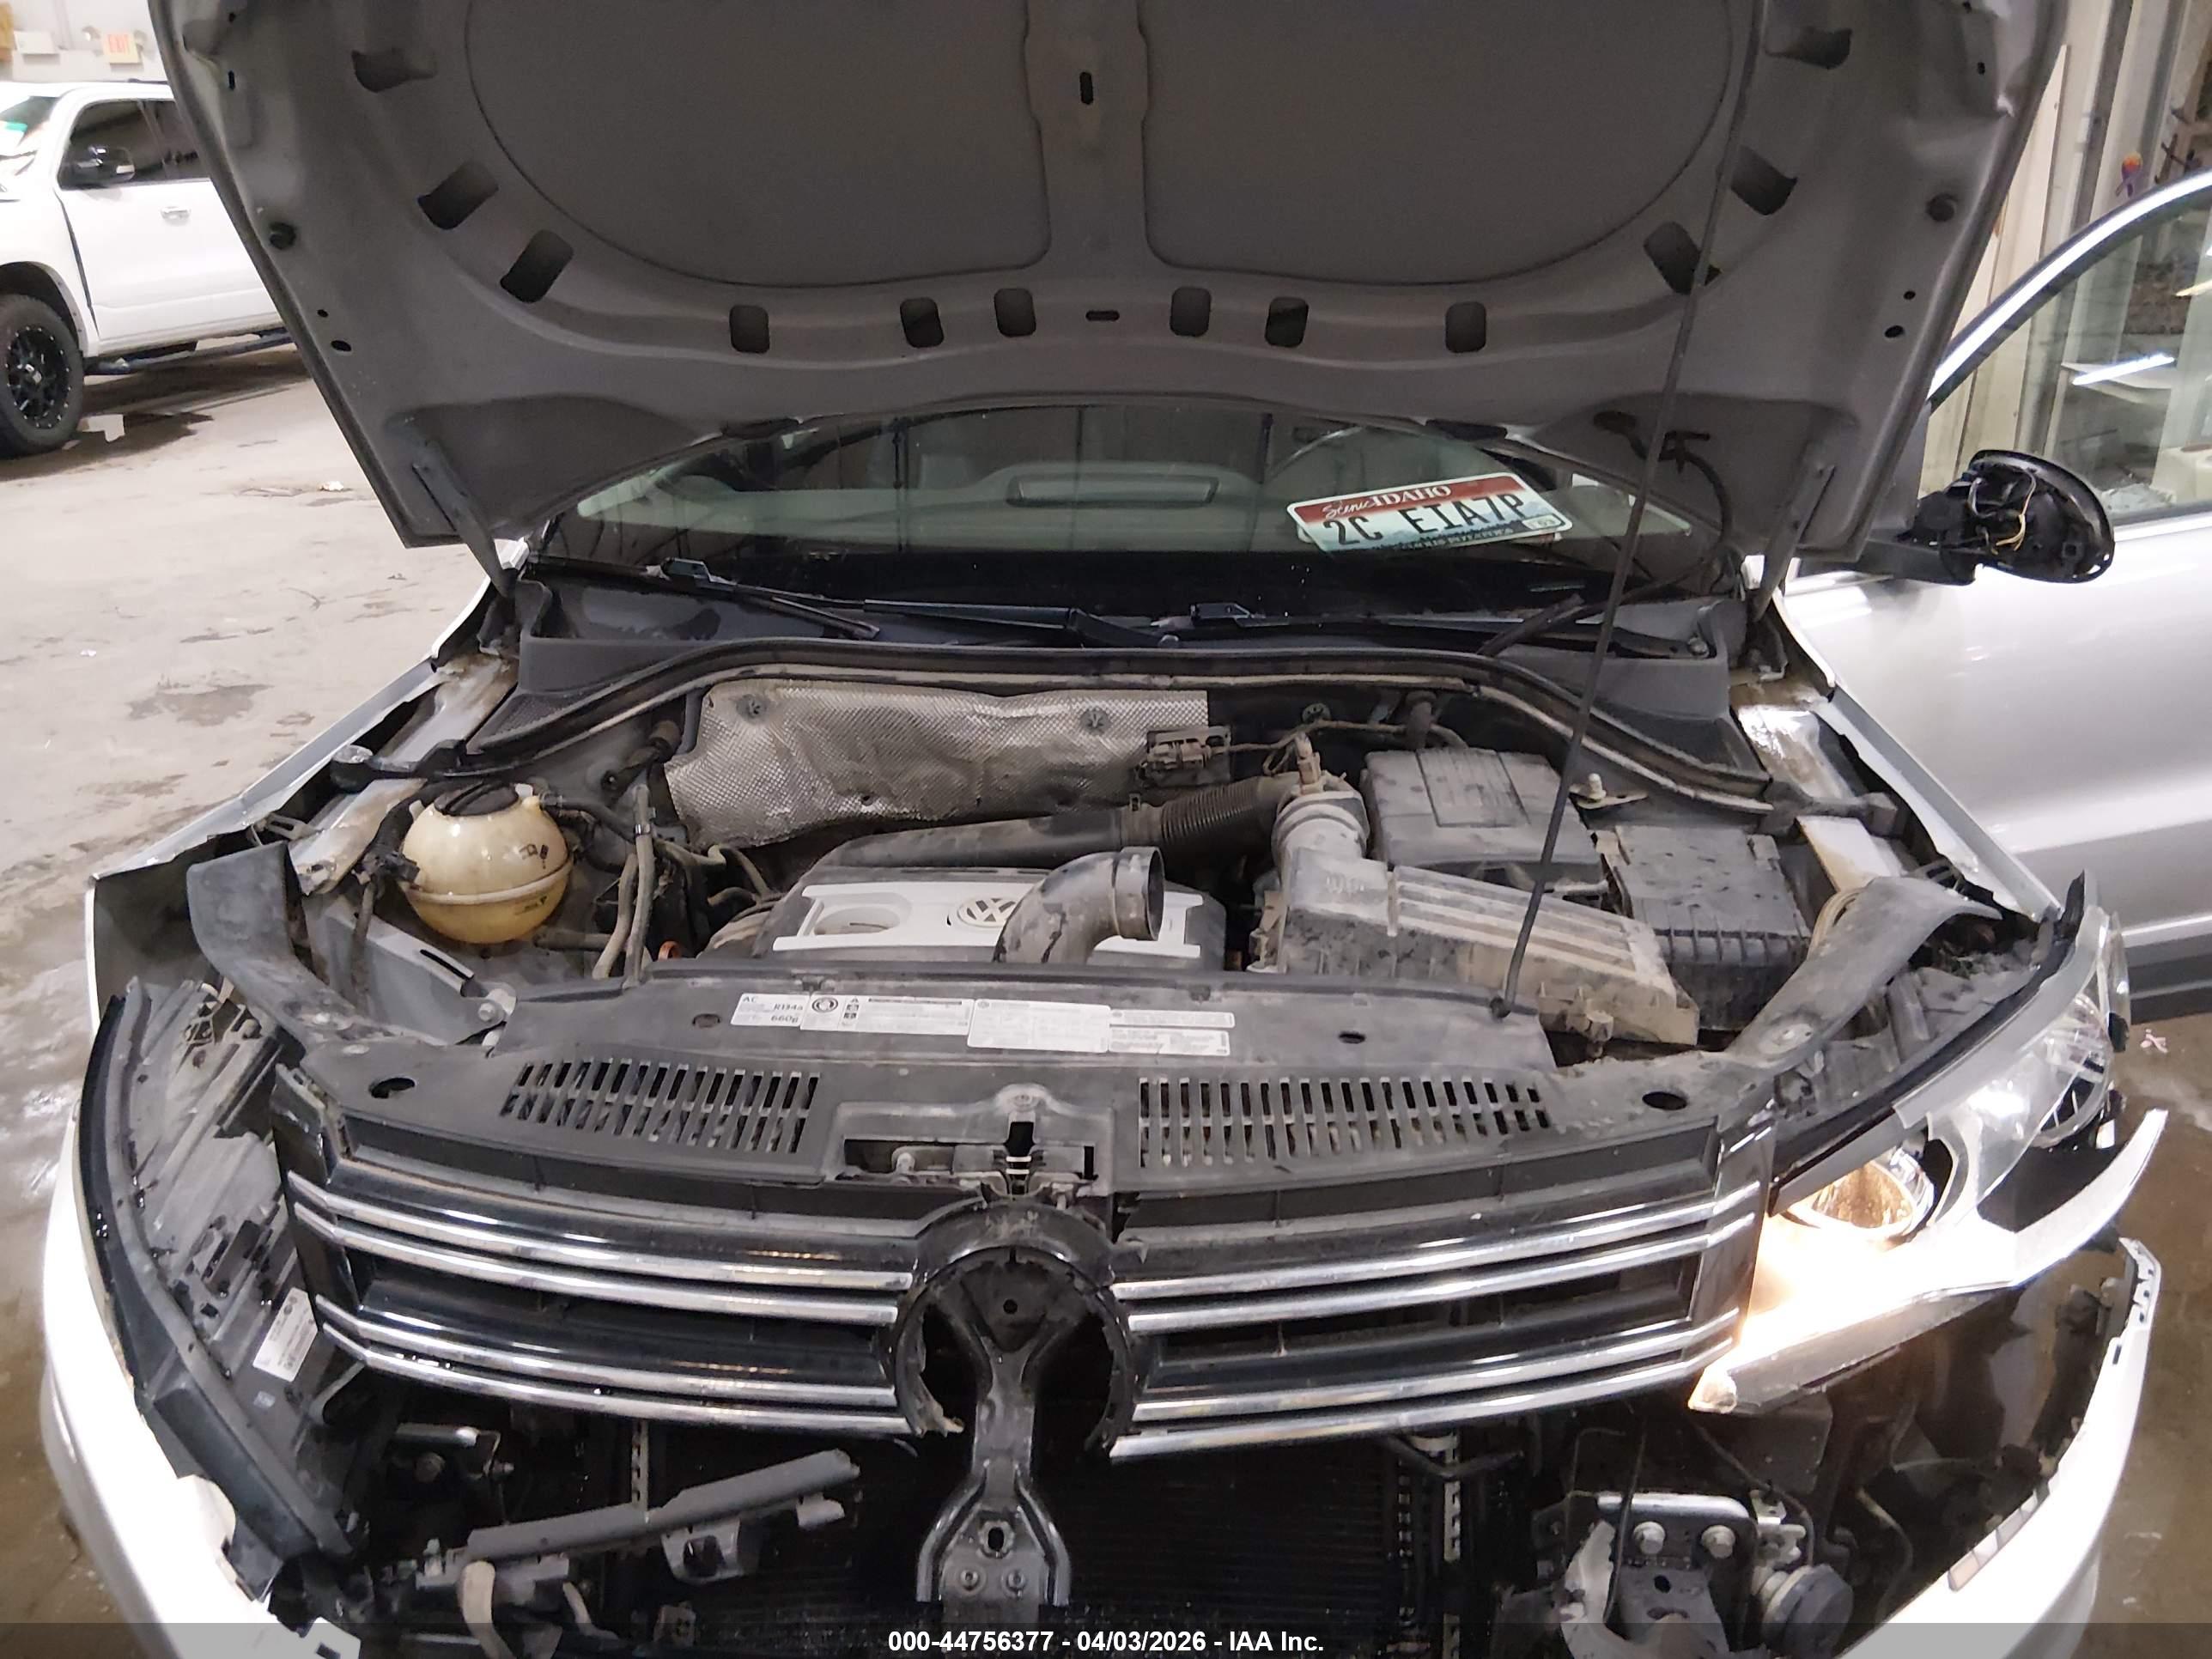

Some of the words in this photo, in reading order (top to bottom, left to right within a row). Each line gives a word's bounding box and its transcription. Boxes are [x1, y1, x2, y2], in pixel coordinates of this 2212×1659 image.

[1322, 499, 1374, 520] Scenic
[1370, 485, 1452, 507] IDAHO
[1323, 515, 1383, 545] 2C
[774, 1003, 804, 1012] R134a
[770, 1014, 799, 1024] 660g
